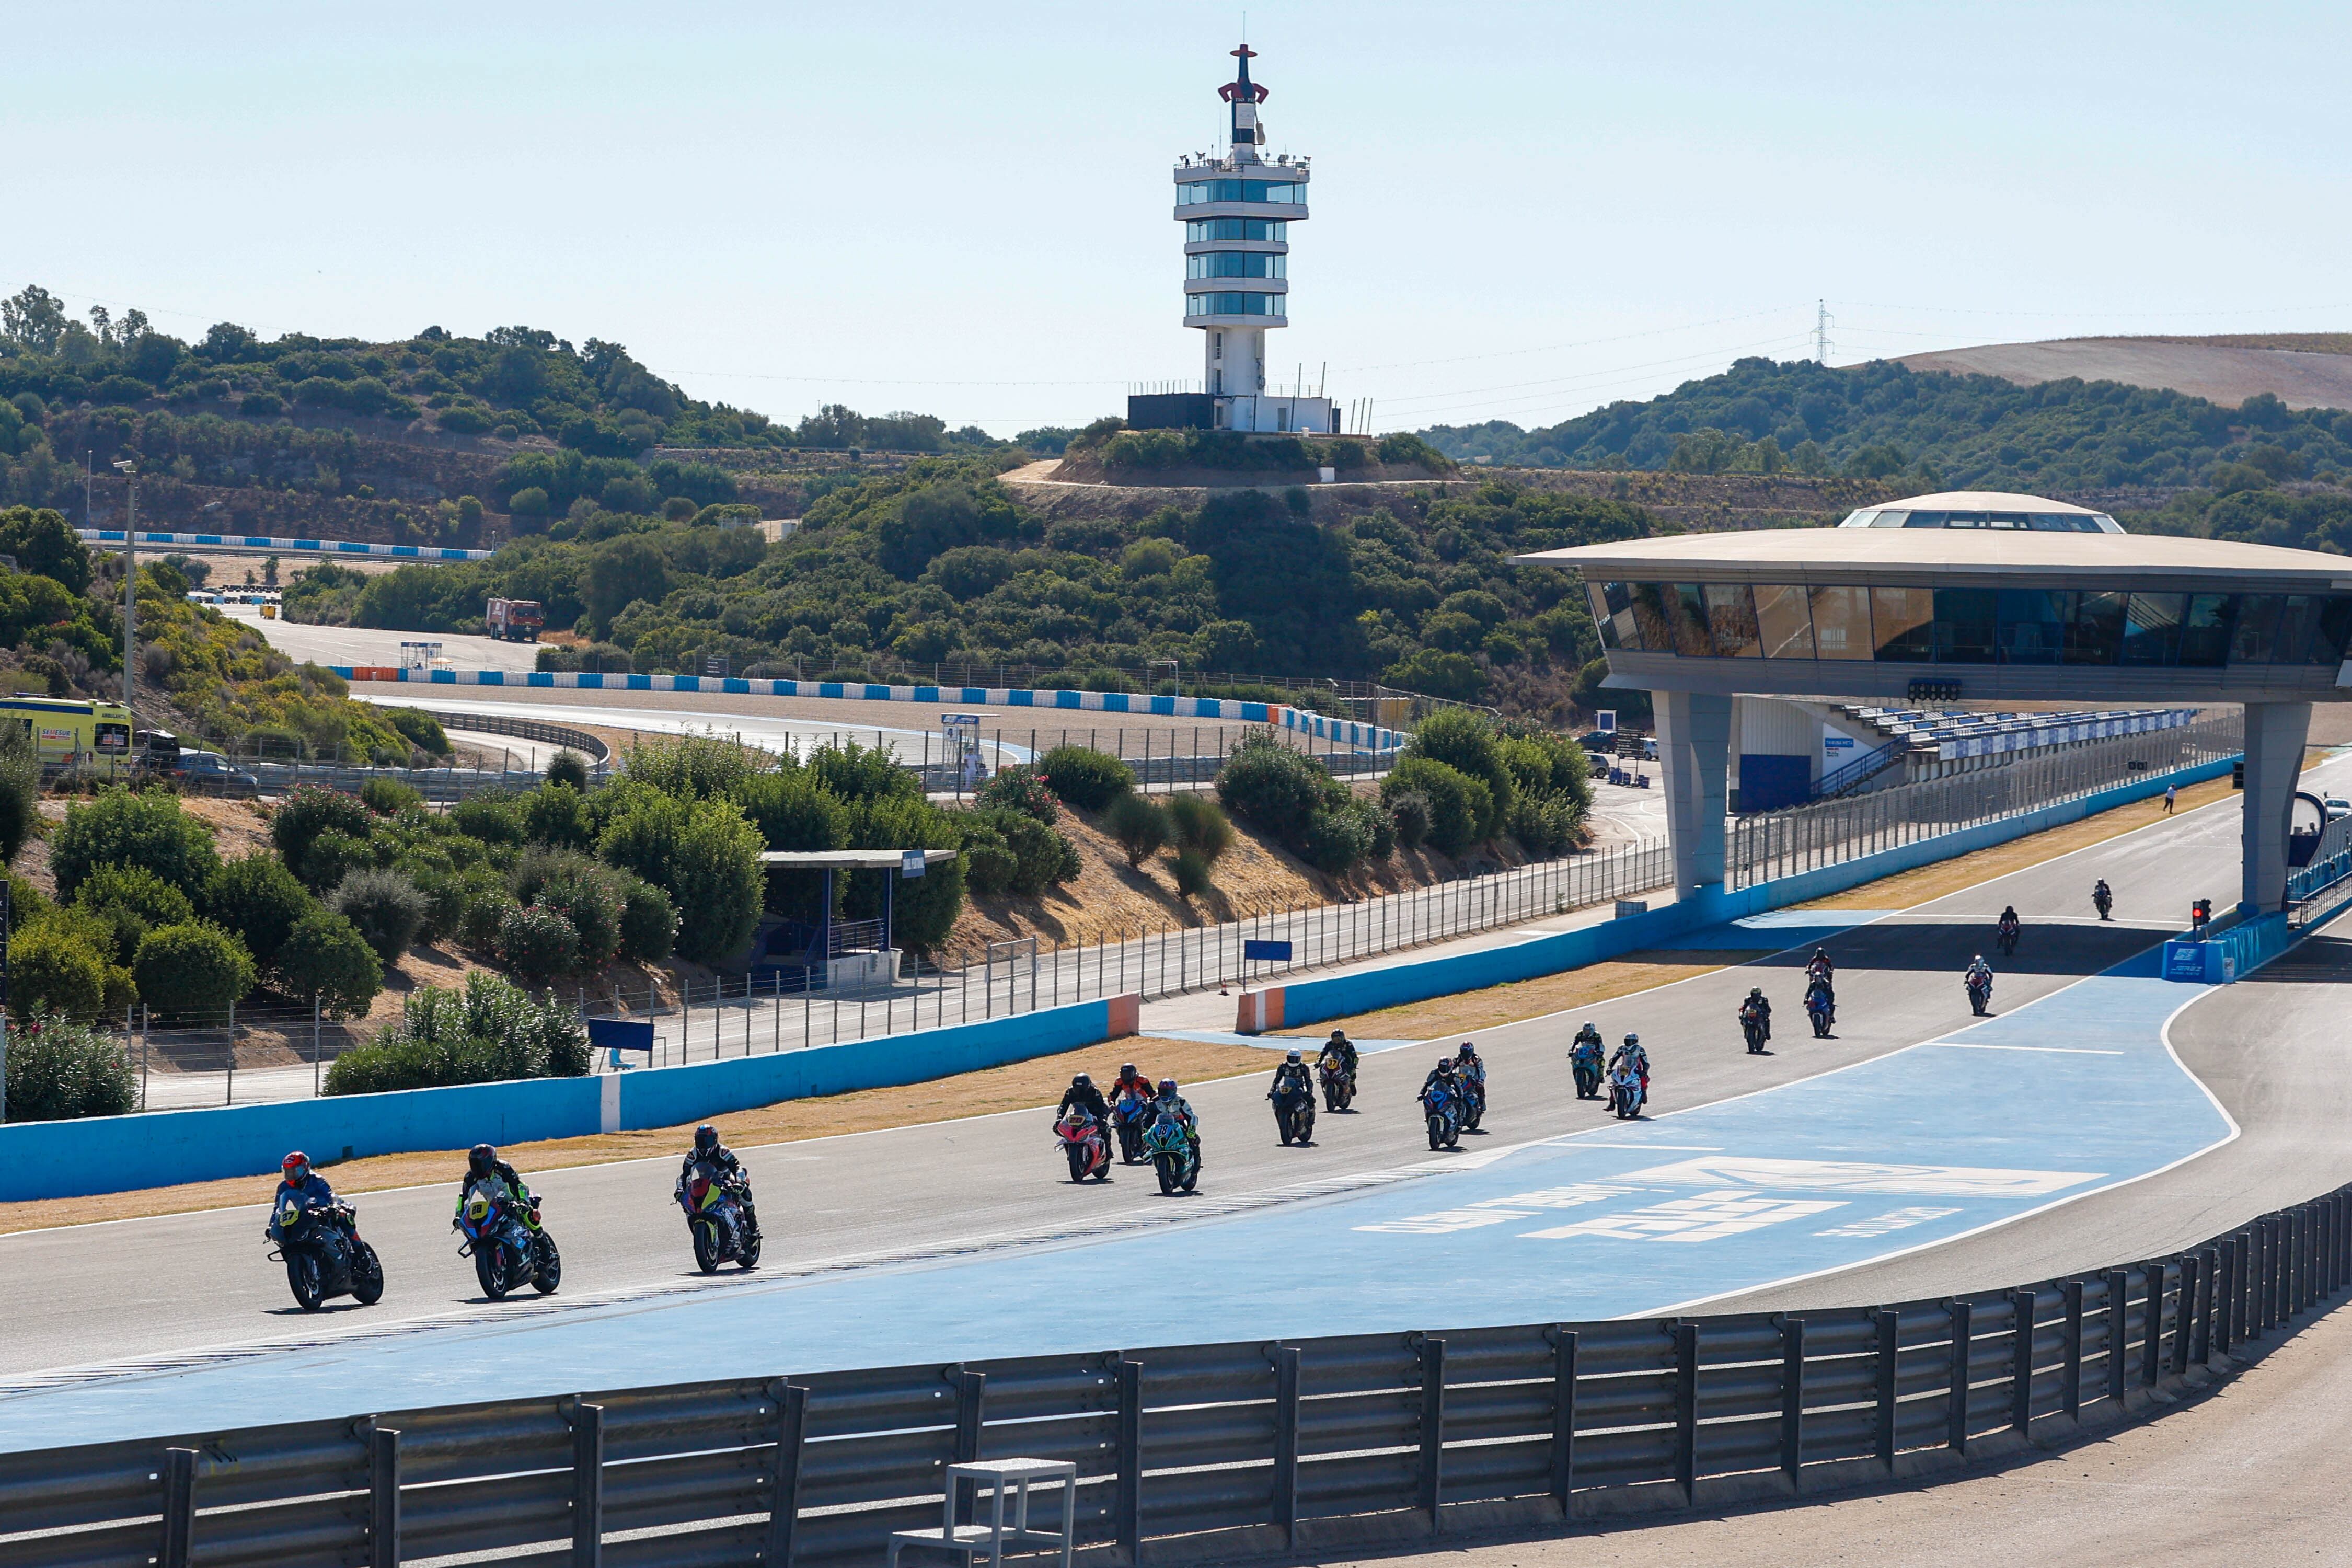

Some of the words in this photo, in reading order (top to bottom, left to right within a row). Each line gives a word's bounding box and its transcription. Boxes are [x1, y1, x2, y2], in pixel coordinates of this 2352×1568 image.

[42, 729, 71, 737] SEMESUR
[948, 728, 953, 738] 4
[1159, 1125, 1168, 1136] 18
[282, 1212, 295, 1222] 27
[1349, 1208, 1543, 1233] NIETO
[1515, 1190, 1853, 1242] JEREZ
[1843, 1207, 1964, 1230] CIRCUITO
[1812, 1228, 1889, 1238] DE
